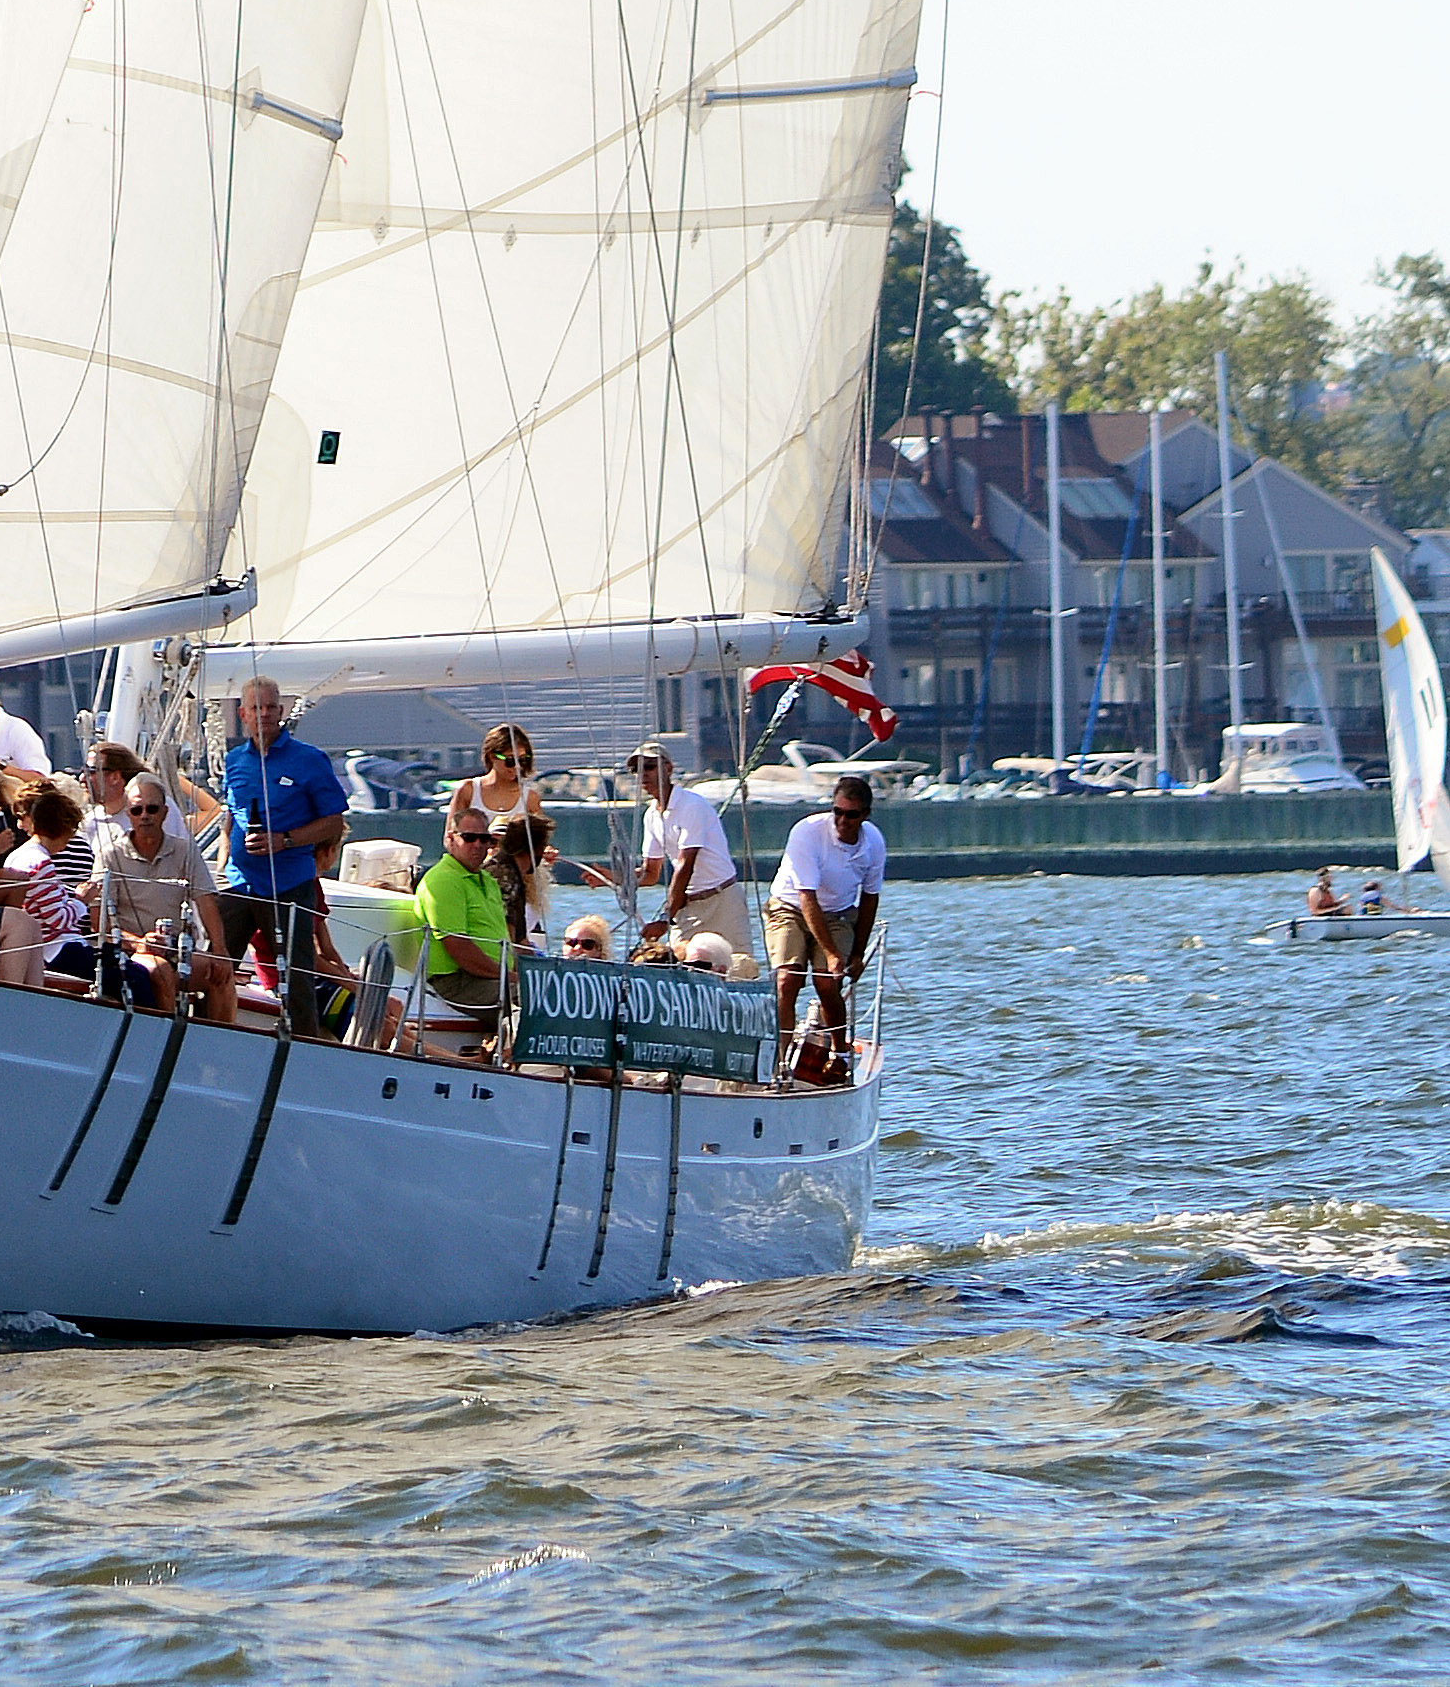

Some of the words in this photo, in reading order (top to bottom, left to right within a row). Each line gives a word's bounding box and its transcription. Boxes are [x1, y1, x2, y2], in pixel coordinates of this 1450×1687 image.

[656, 980, 728, 1033] SAILING
[528, 1036, 536, 1054] 2
[537, 1034, 569, 1055] HOUR
